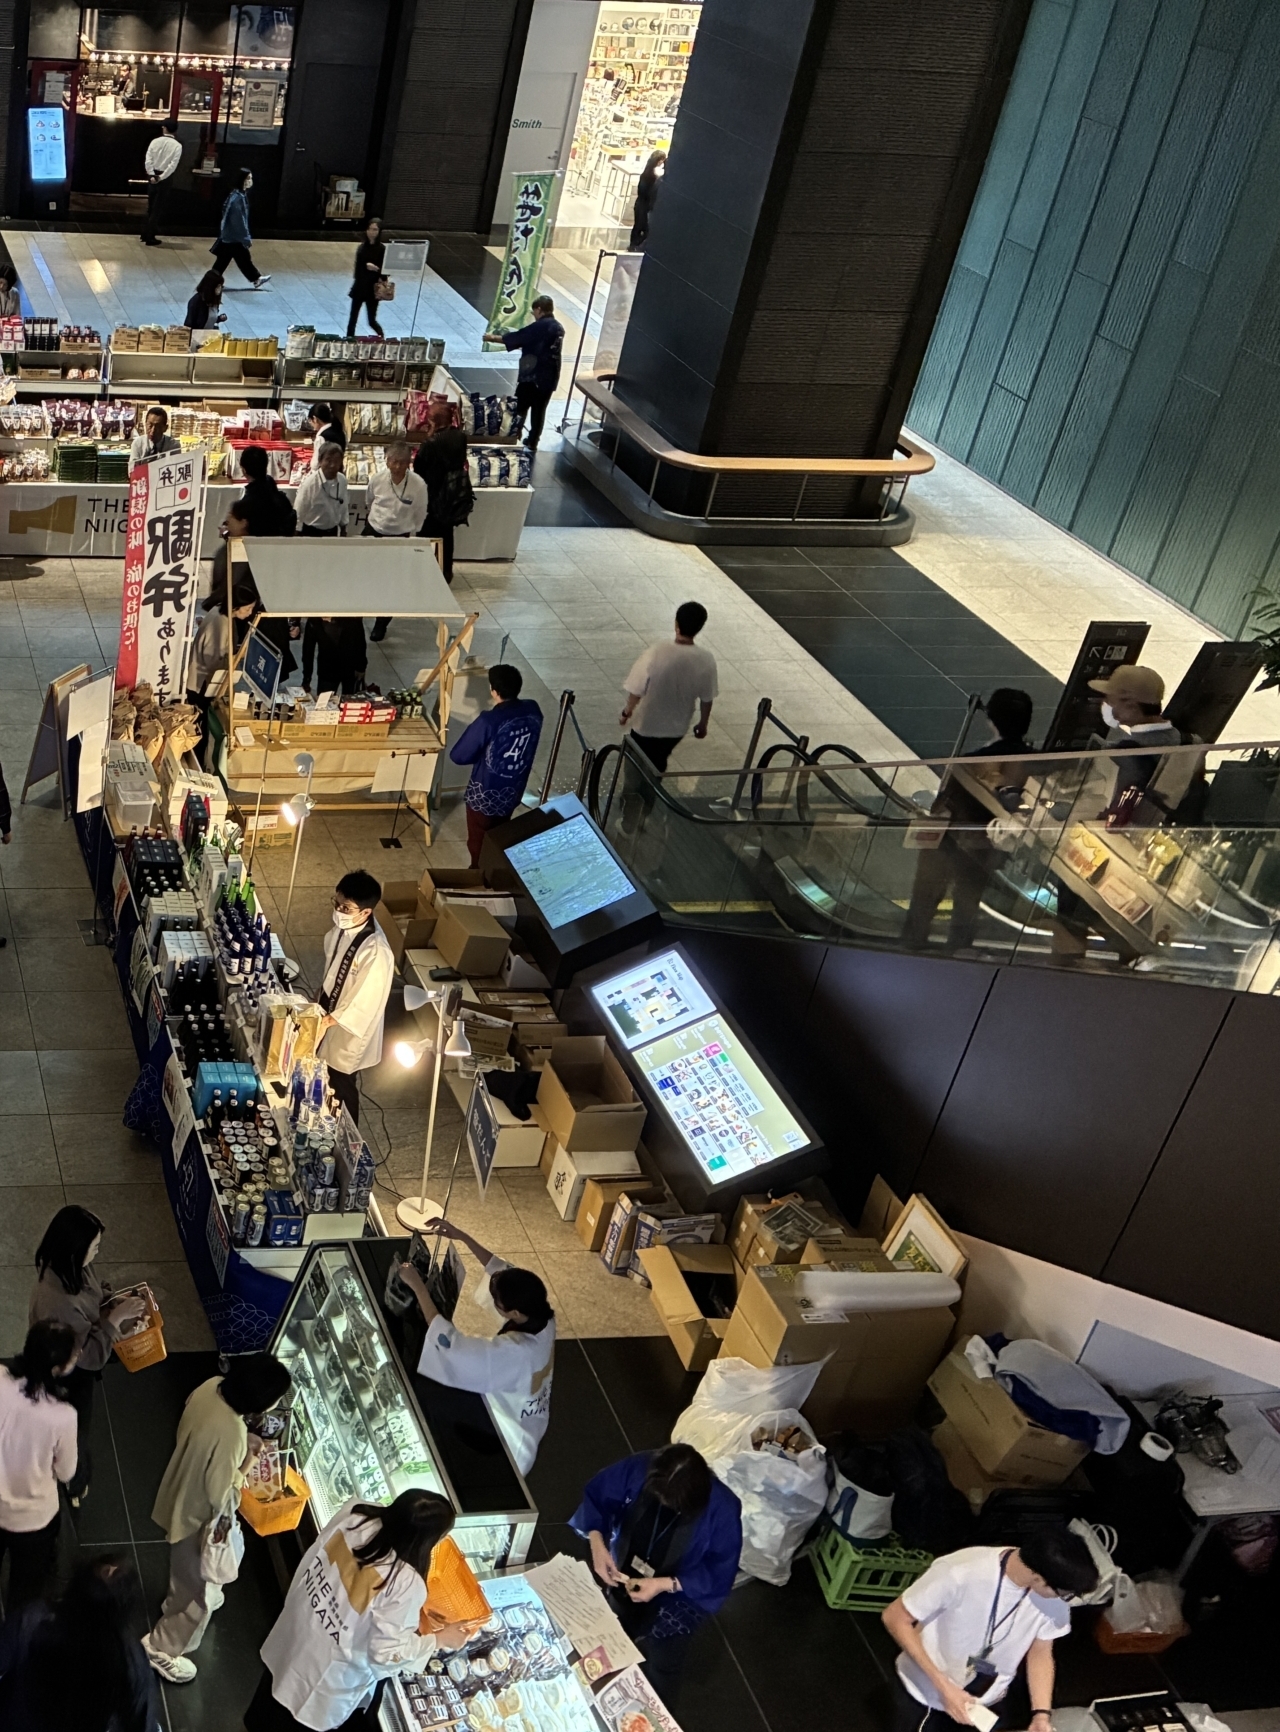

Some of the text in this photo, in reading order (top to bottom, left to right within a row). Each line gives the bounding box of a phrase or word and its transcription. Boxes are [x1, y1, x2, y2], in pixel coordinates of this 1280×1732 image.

[512, 118, 543, 129] Smith
[313, 1555, 333, 1598] THE
[302, 1568, 340, 1646] NIIGATA
